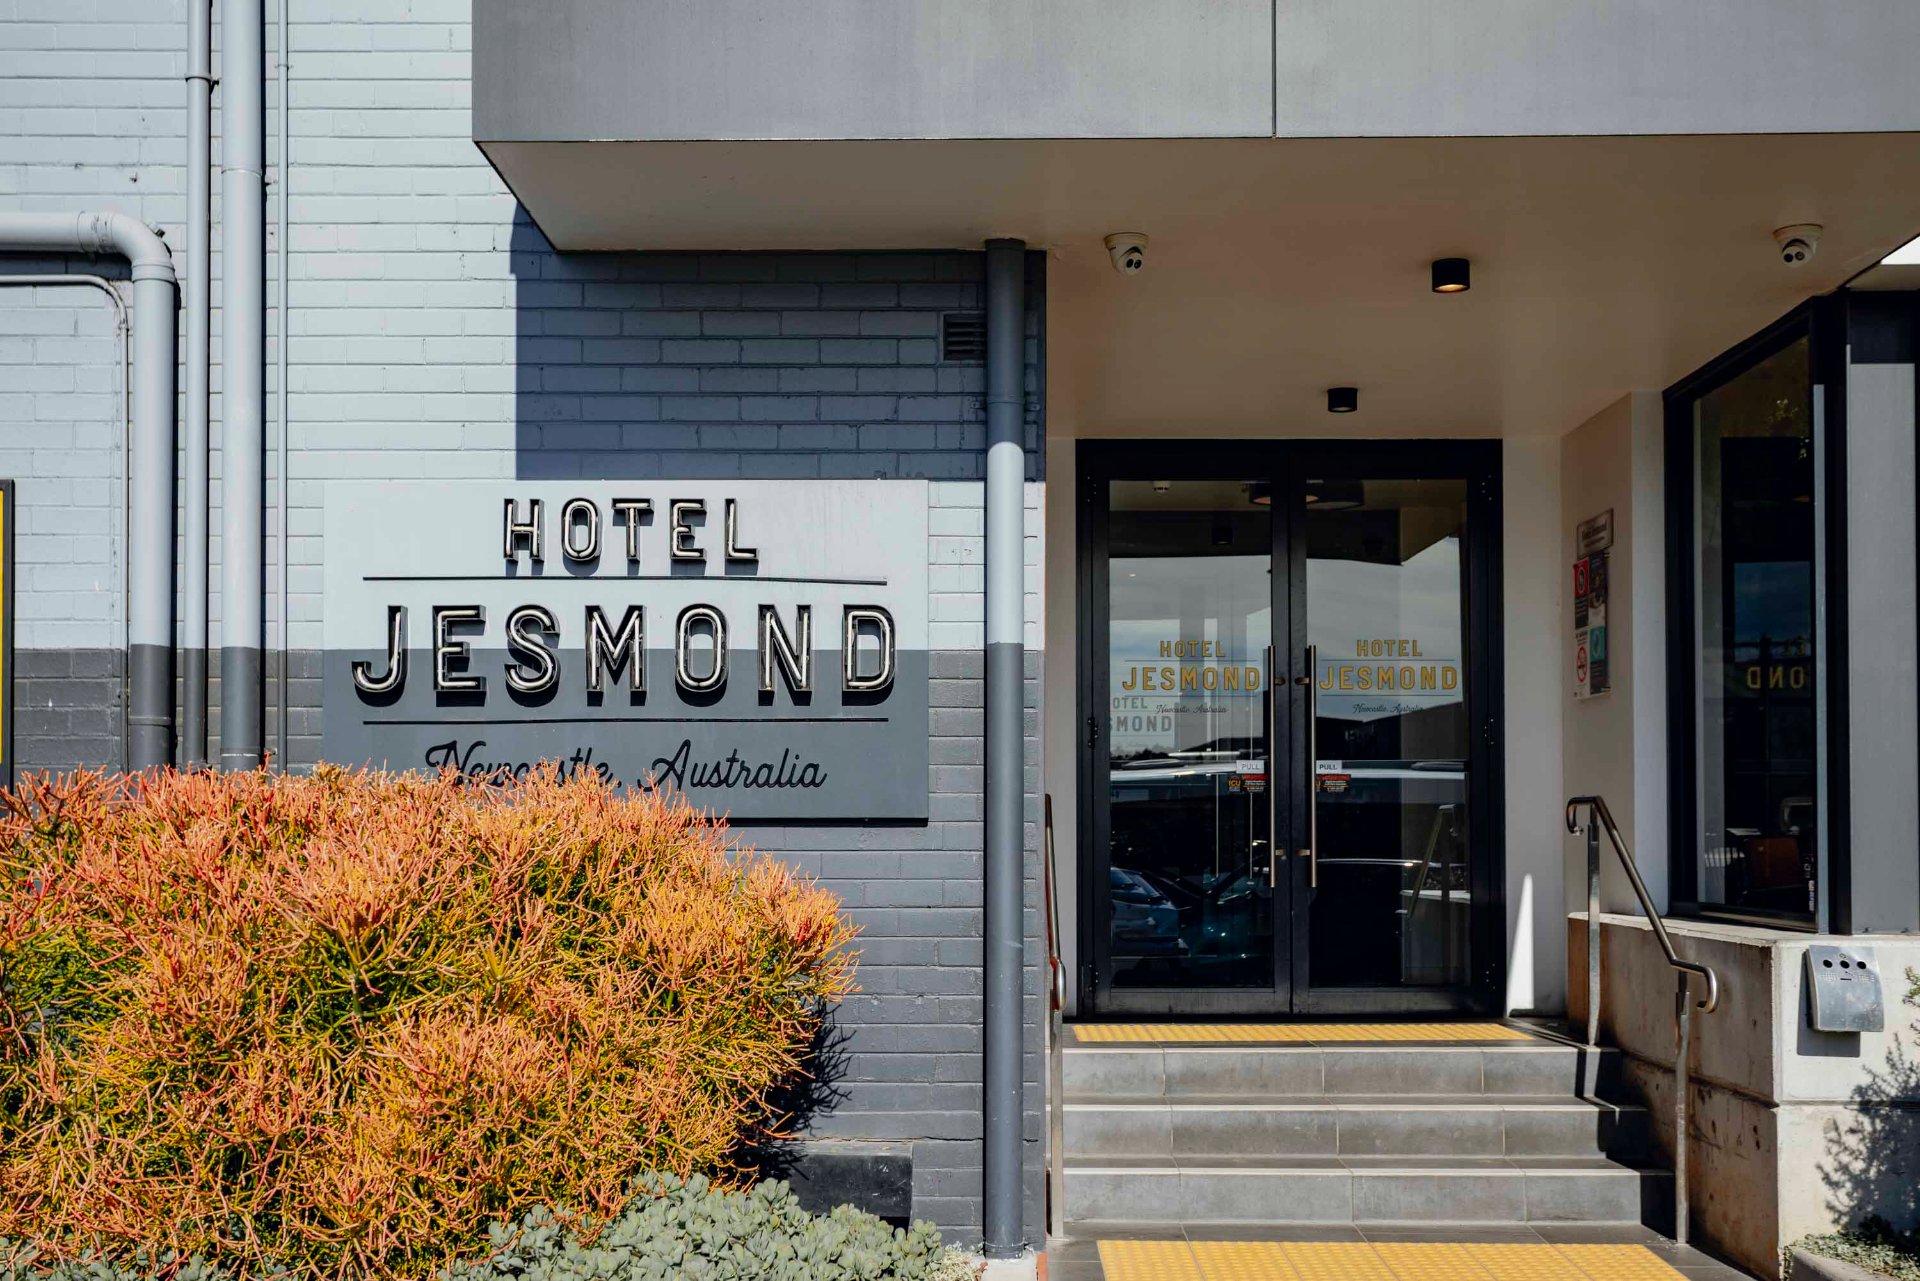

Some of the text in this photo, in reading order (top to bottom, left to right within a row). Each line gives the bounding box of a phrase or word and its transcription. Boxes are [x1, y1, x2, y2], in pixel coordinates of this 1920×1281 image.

[503, 498, 758, 562] HOTEL
[352, 605, 896, 694] JESMOND
[1159, 640, 1226, 657] HOTEL
[1356, 639, 1423, 657] HOTEL
[1122, 667, 1260, 691] JESMOND
[1319, 666, 1457, 690] JESMOND
[637, 739, 828, 792] Australia
